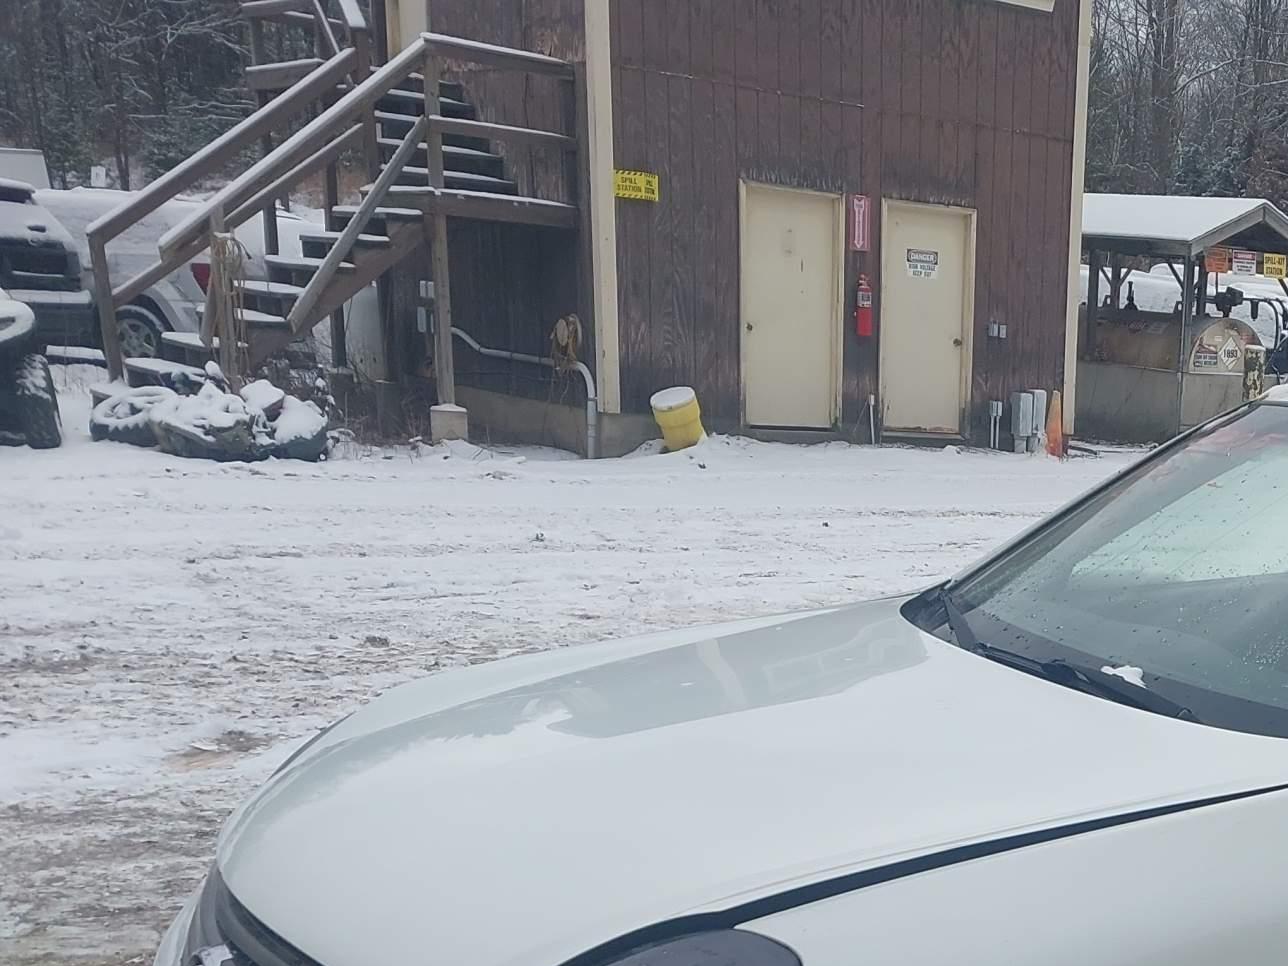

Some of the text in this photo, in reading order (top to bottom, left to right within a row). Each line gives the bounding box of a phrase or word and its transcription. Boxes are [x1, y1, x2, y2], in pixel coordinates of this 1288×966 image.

[621, 176, 637, 184] SPILL
[617, 184, 642, 193] STATION
[911, 253, 934, 261] DANGER
[1265, 266, 1283, 276] STATION
